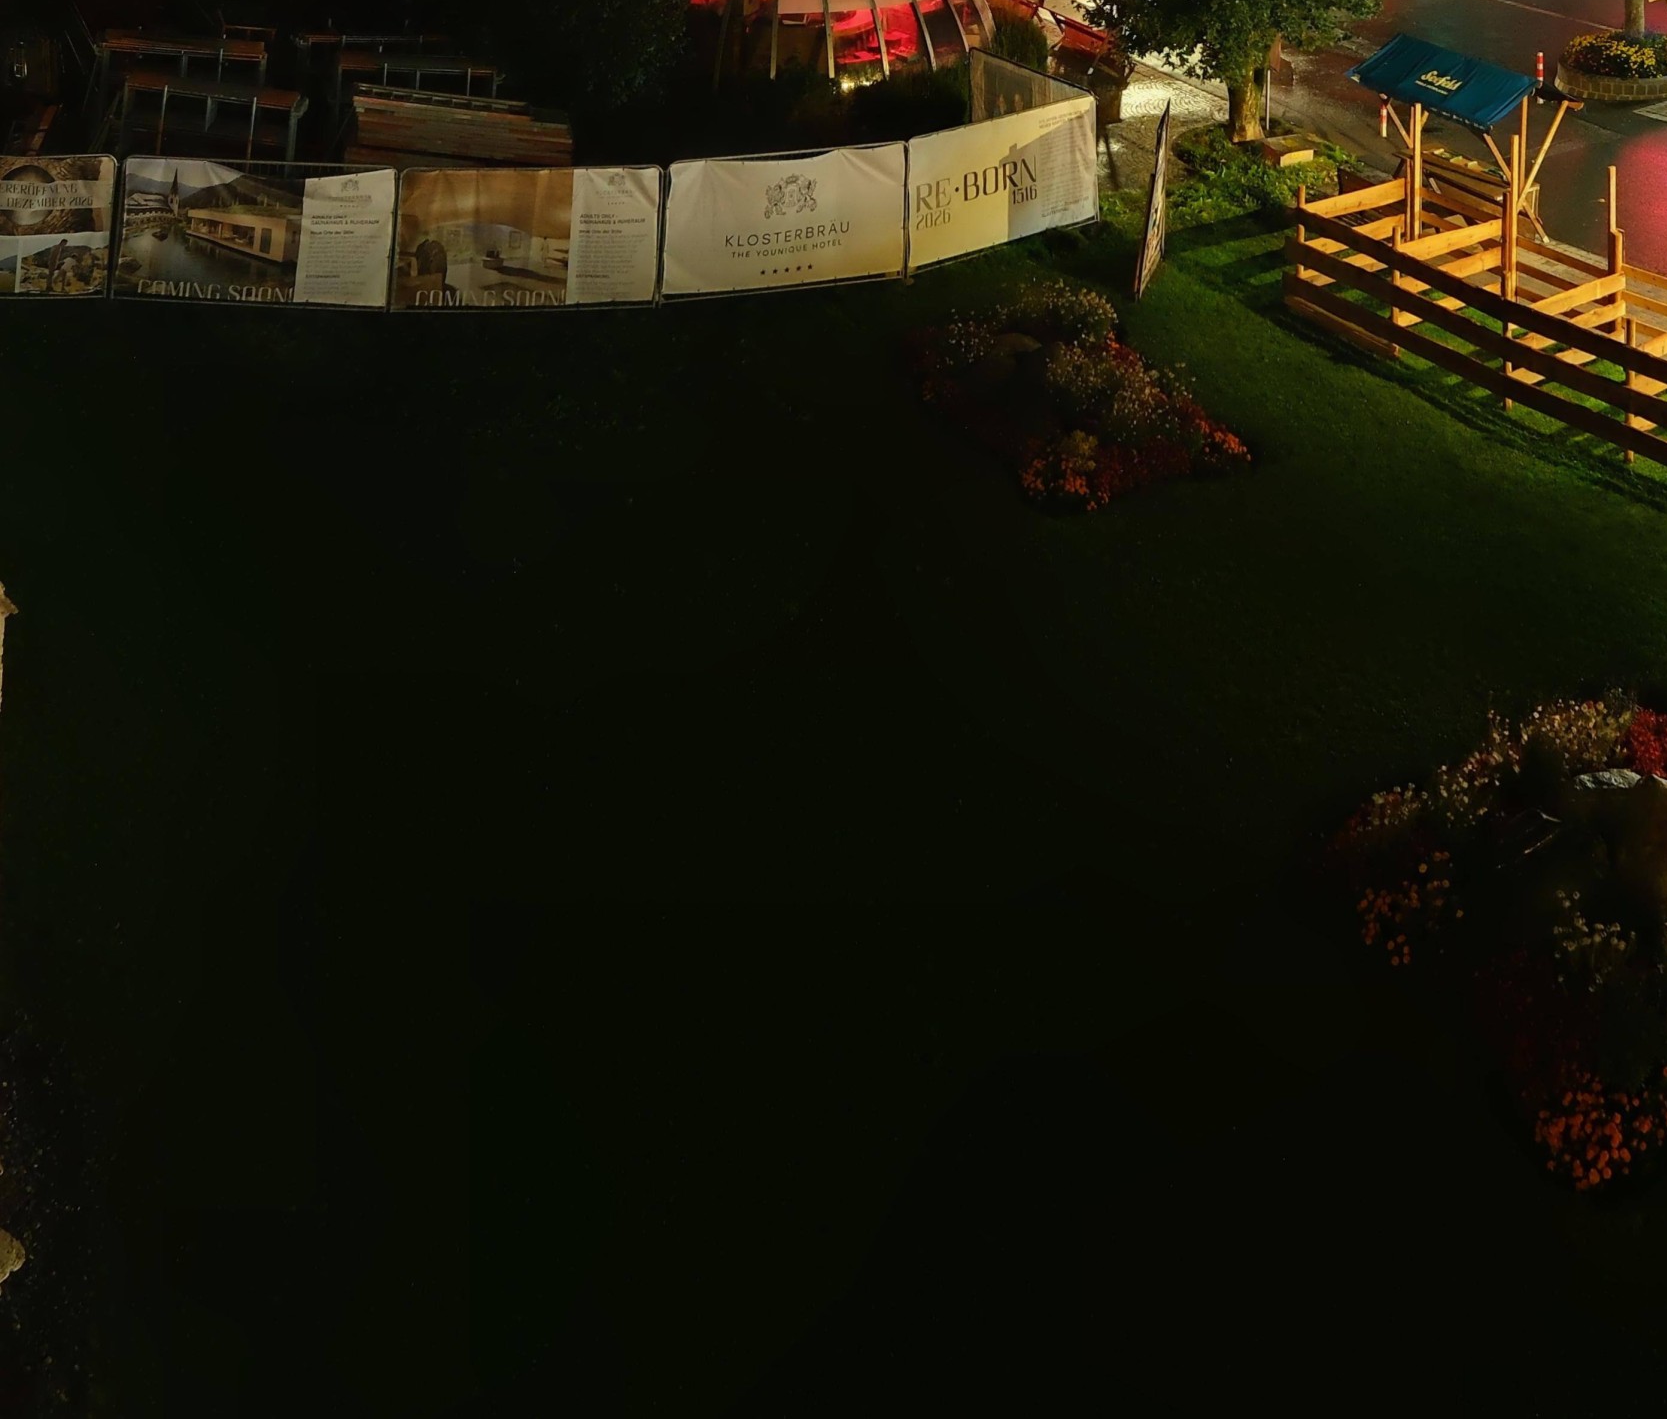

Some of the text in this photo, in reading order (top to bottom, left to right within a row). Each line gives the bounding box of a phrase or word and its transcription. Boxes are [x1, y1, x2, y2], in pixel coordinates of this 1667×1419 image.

[1420, 70, 1463, 91] Seefeld
[1012, 184, 1038, 205] 1516
[916, 209, 951, 231] 2026
[725, 219, 851, 248] KLOSTERBRÄU
[731, 239, 842, 259] THE YOUNIQUE HOTEL
